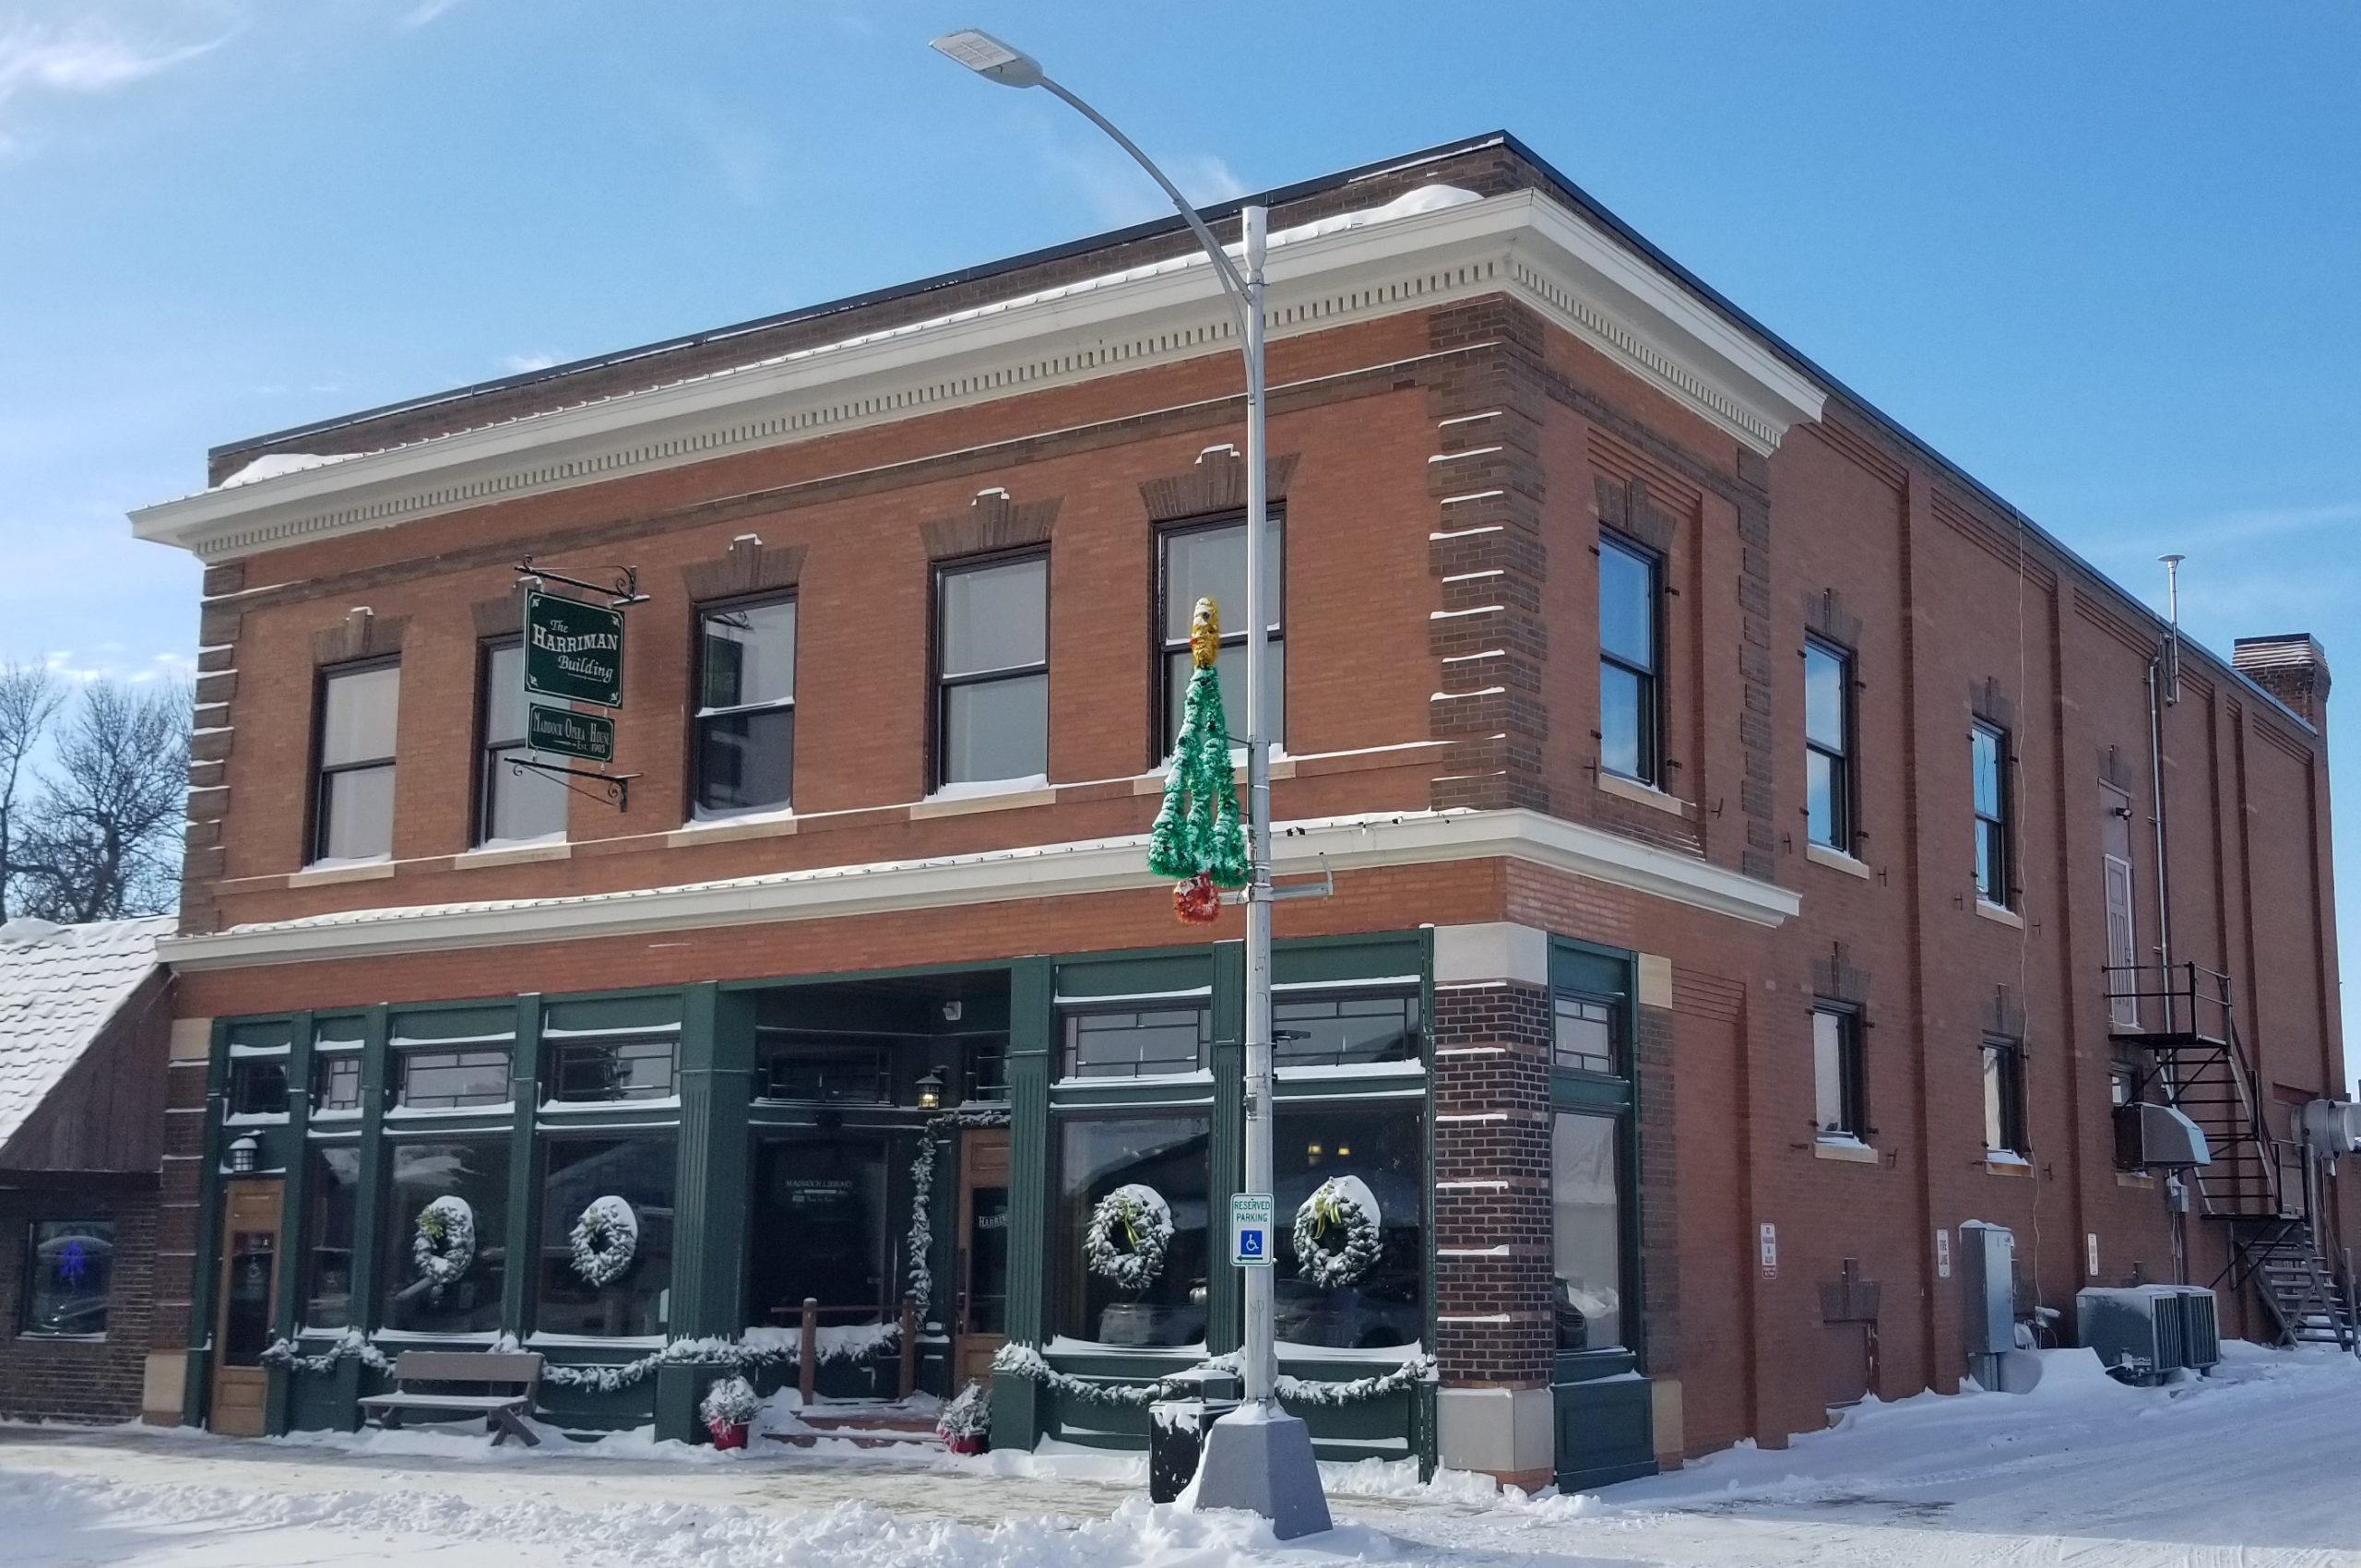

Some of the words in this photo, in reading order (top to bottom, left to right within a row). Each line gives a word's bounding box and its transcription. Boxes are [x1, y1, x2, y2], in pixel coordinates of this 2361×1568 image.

[550, 619, 569, 634] The
[532, 624, 619, 653] HARRIMAN
[557, 655, 613, 683] Building
[1234, 1201, 1270, 1210] RESERVED
[1236, 1213, 1268, 1222] PARKING
